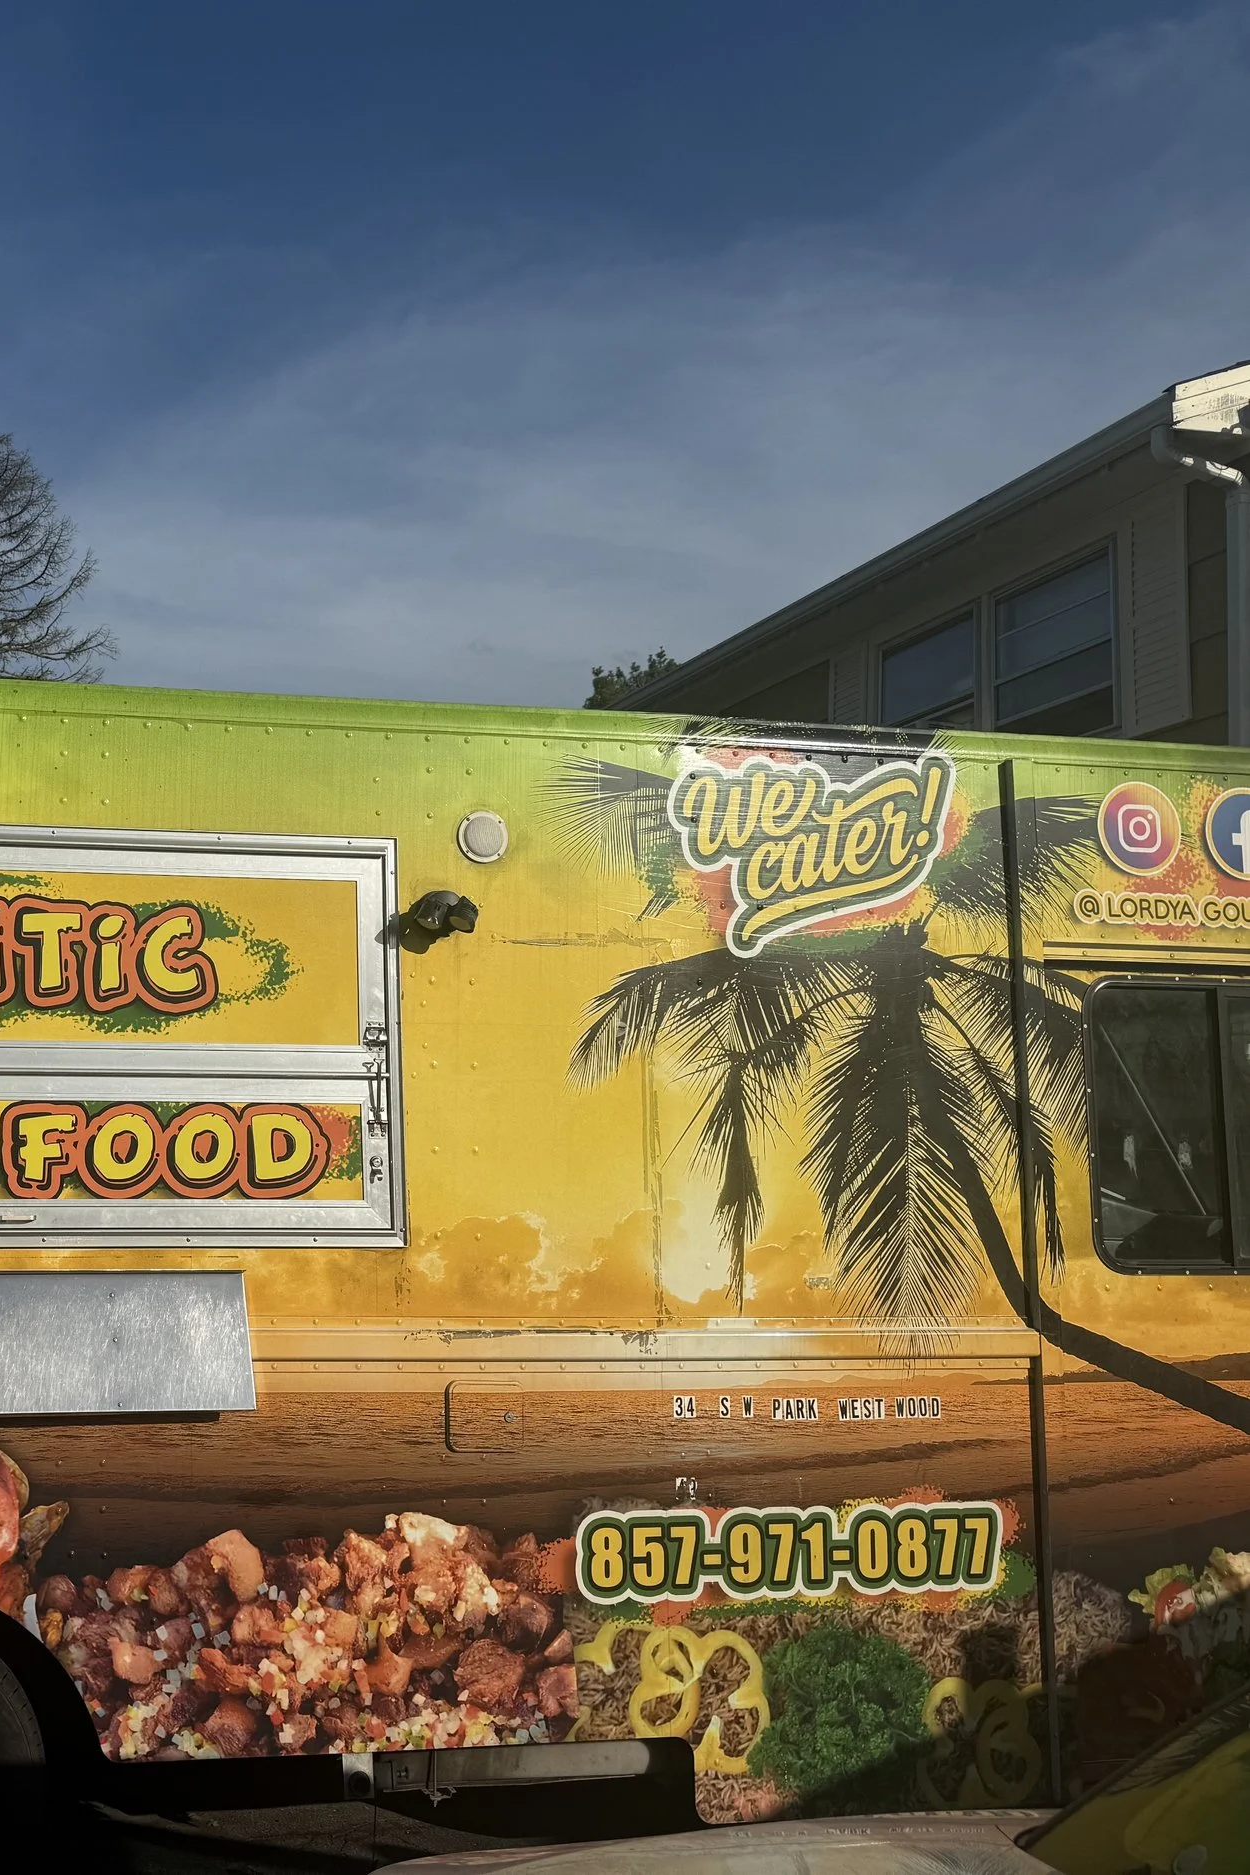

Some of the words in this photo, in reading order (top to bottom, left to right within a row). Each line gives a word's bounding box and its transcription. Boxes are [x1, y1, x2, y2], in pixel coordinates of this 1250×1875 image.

[683, 768, 816, 856] We
[745, 766, 944, 902] cater!
[1107, 896, 1196, 921] LORDYA
[15, 1108, 326, 1198] FOOD
[674, 1396, 696, 1418] 34
[720, 1397, 730, 1417] S
[743, 1396, 753, 1417] W
[772, 1399, 818, 1420] PARK
[838, 1399, 885, 1421] WEST
[895, 1397, 941, 1419] WOOD
[588, 1515, 993, 1592] 857-971-0877
